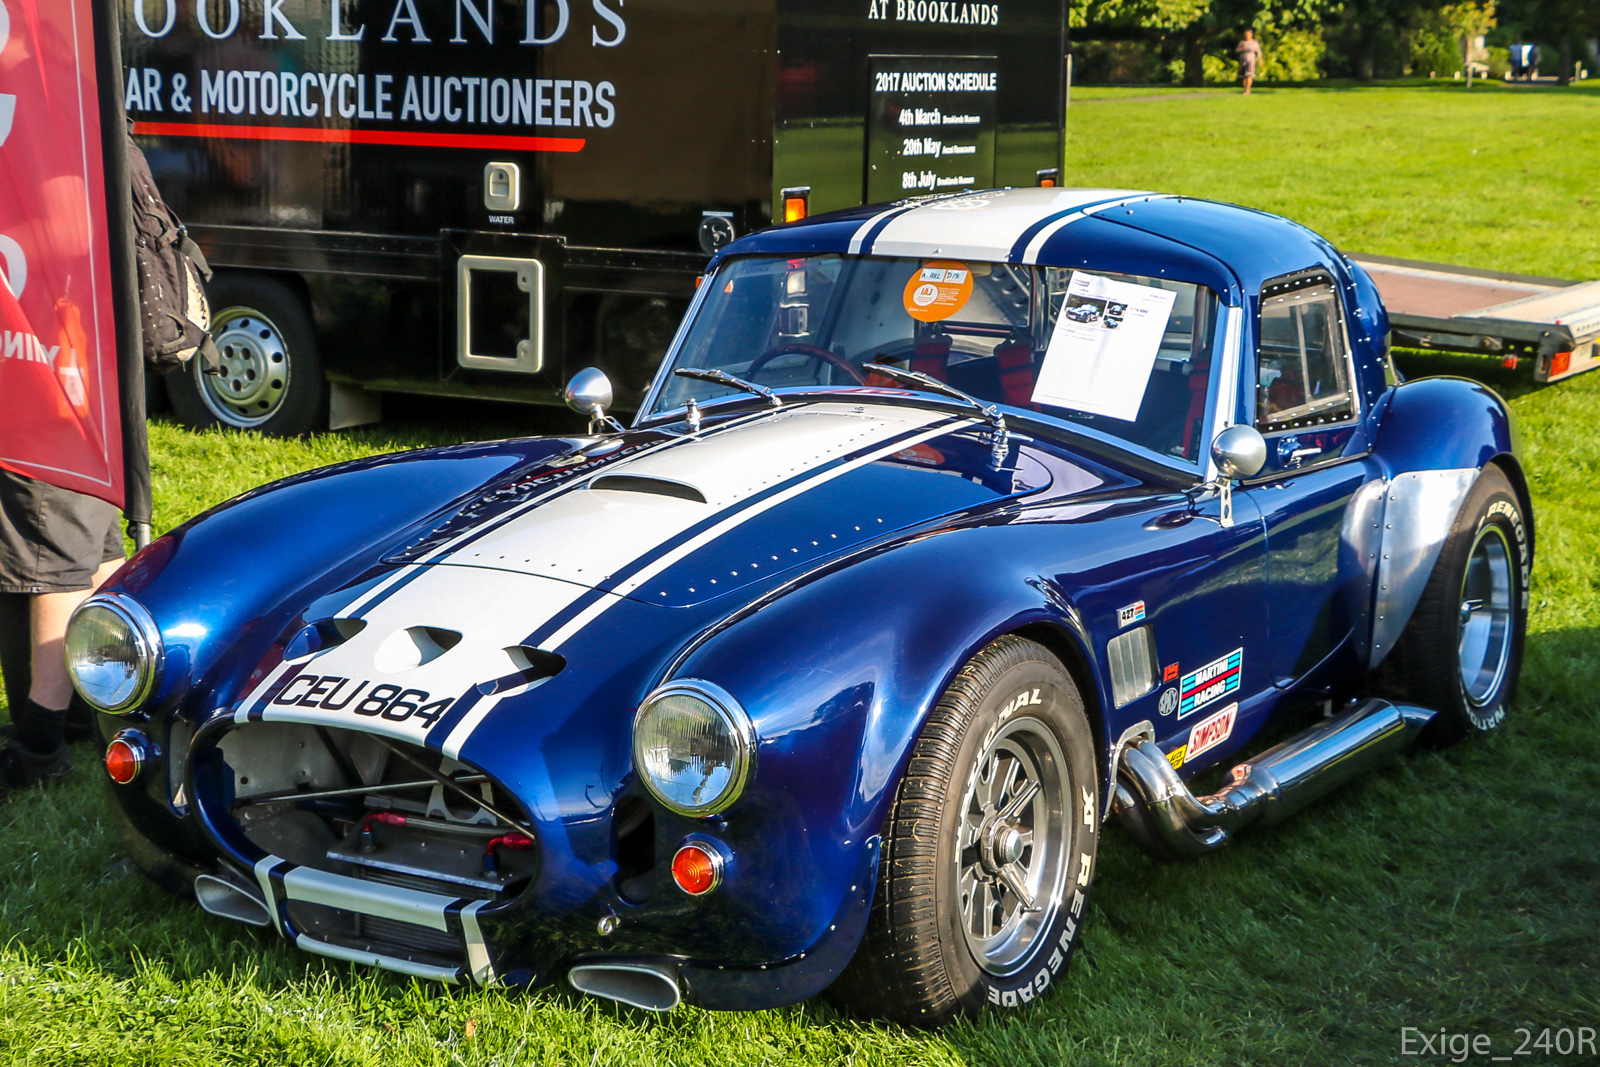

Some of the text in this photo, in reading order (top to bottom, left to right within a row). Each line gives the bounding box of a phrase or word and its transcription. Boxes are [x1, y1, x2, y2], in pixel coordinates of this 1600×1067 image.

[868, 0, 999, 26] AT BROOKLANDS
[875, 72, 997, 92] 2017 AUCTION SCHEDULE
[171, 73, 192, 114] &
[200, 69, 393, 120] MOTORCYCLE
[400, 75, 616, 128] AUCTIONEERS
[898, 108, 914, 126] 4th
[915, 108, 941, 126] March
[902, 138, 922, 156] 20th
[923, 137, 942, 158] May
[902, 171, 917, 189] 8th
[918, 170, 937, 191] July
[488, 215, 515, 225] WATER
[1121, 607, 1134, 621] 427
[1194, 658, 1229, 686] MARTINI
[272, 674, 456, 729] CEU 864
[1193, 679, 1226, 707] RACING
[1189, 711, 1233, 754] SIMPSON
[988, 785, 1095, 1007] XT RENEGADE
